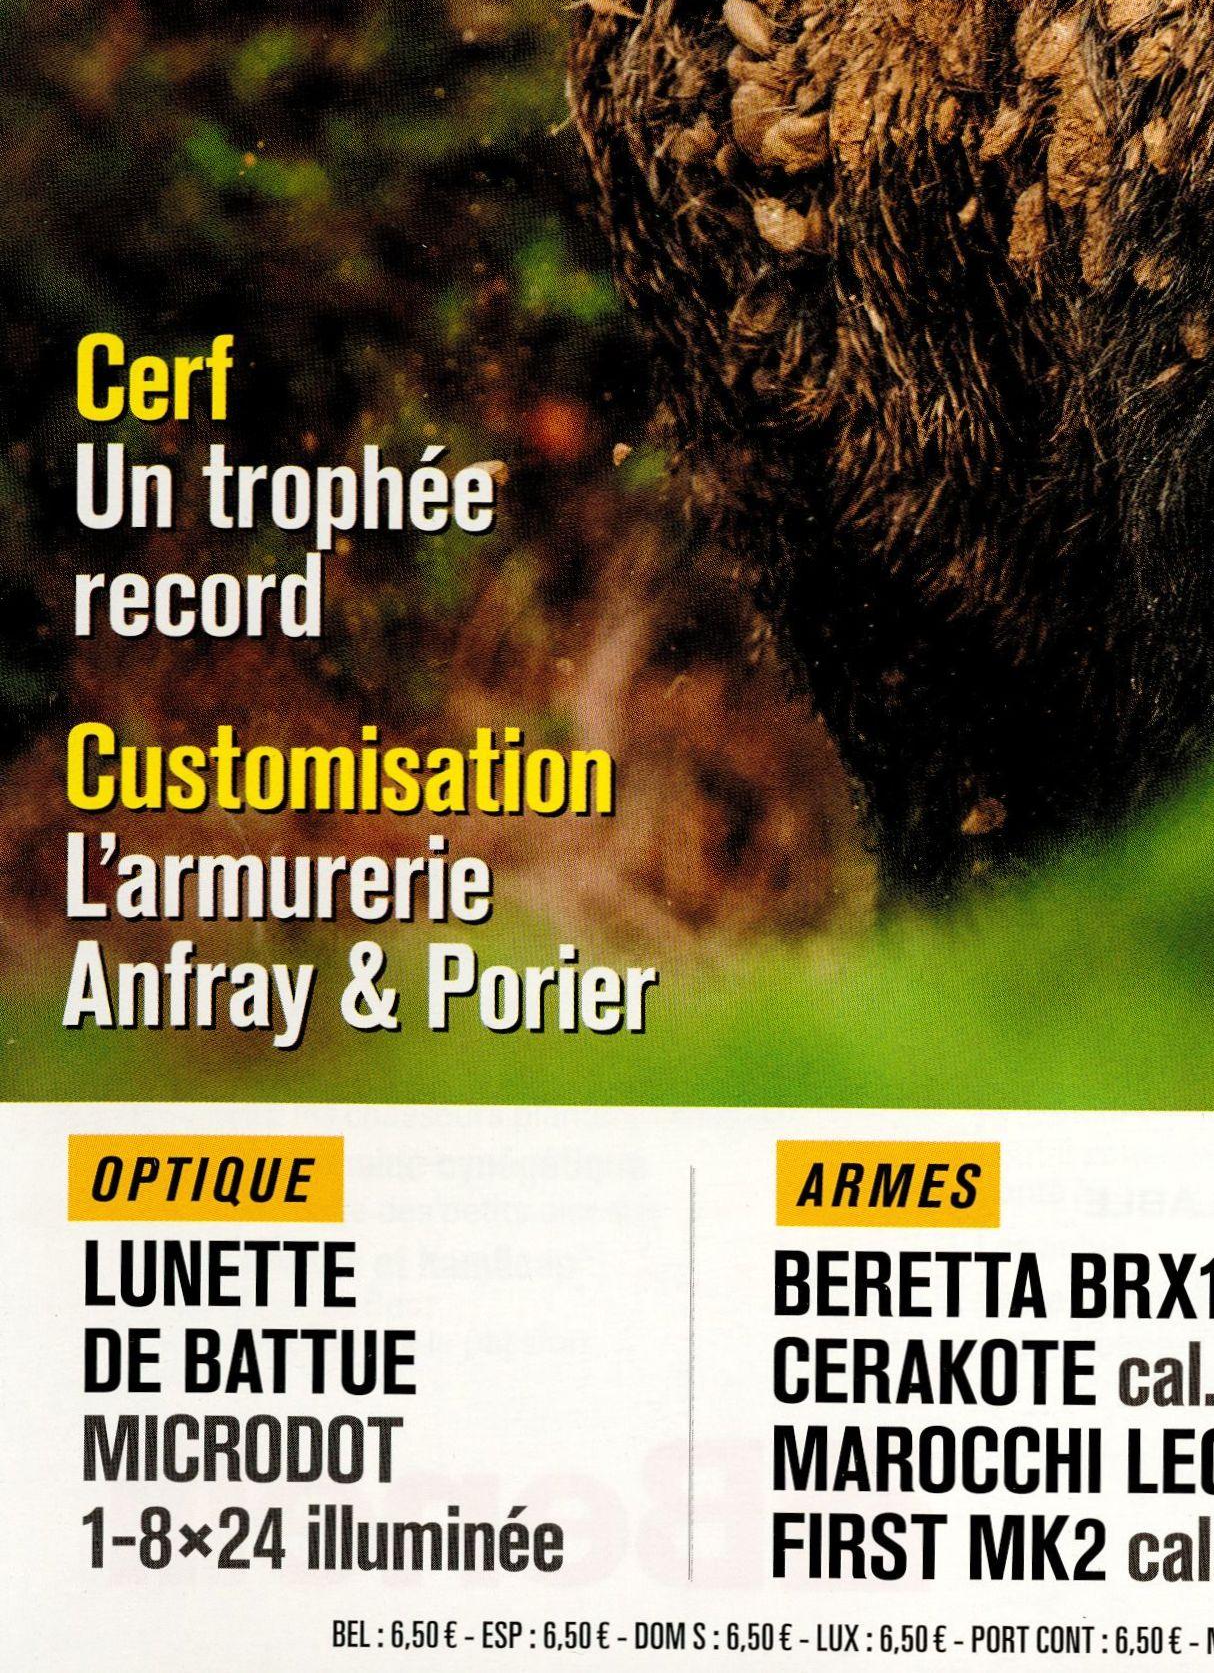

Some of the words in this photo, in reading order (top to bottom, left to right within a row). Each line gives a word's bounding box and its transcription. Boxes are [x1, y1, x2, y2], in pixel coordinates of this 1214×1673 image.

[77, 332, 234, 421] Cerf
[76, 443, 172, 530] Un
[203, 443, 493, 550] trophée
[75, 553, 321, 637] record
[67, 722, 612, 813] Customisation
[62, 941, 313, 1048] Anfray
[340, 941, 397, 1029] &
[428, 943, 656, 1031] Porier
[92, 1156, 315, 1206] OPTIQUE
[796, 1163, 981, 1209] ARMES
[84, 1240, 356, 1307] LUNETTE
[774, 1250, 1047, 1318] BERETTA
[84, 1328, 161, 1393] DE
[185, 1329, 417, 1395] BATTUE
[773, 1336, 1097, 1406] CERAKOTE
[84, 1414, 404, 1483] MICRODOT
[773, 1425, 1102, 1495] MAROCCHI
[308, 1504, 564, 1573] illuminée
[773, 1513, 948, 1581] FIRST
[969, 1515, 1106, 1581] MK2
[971, 1625, 1030, 1654] PORT
